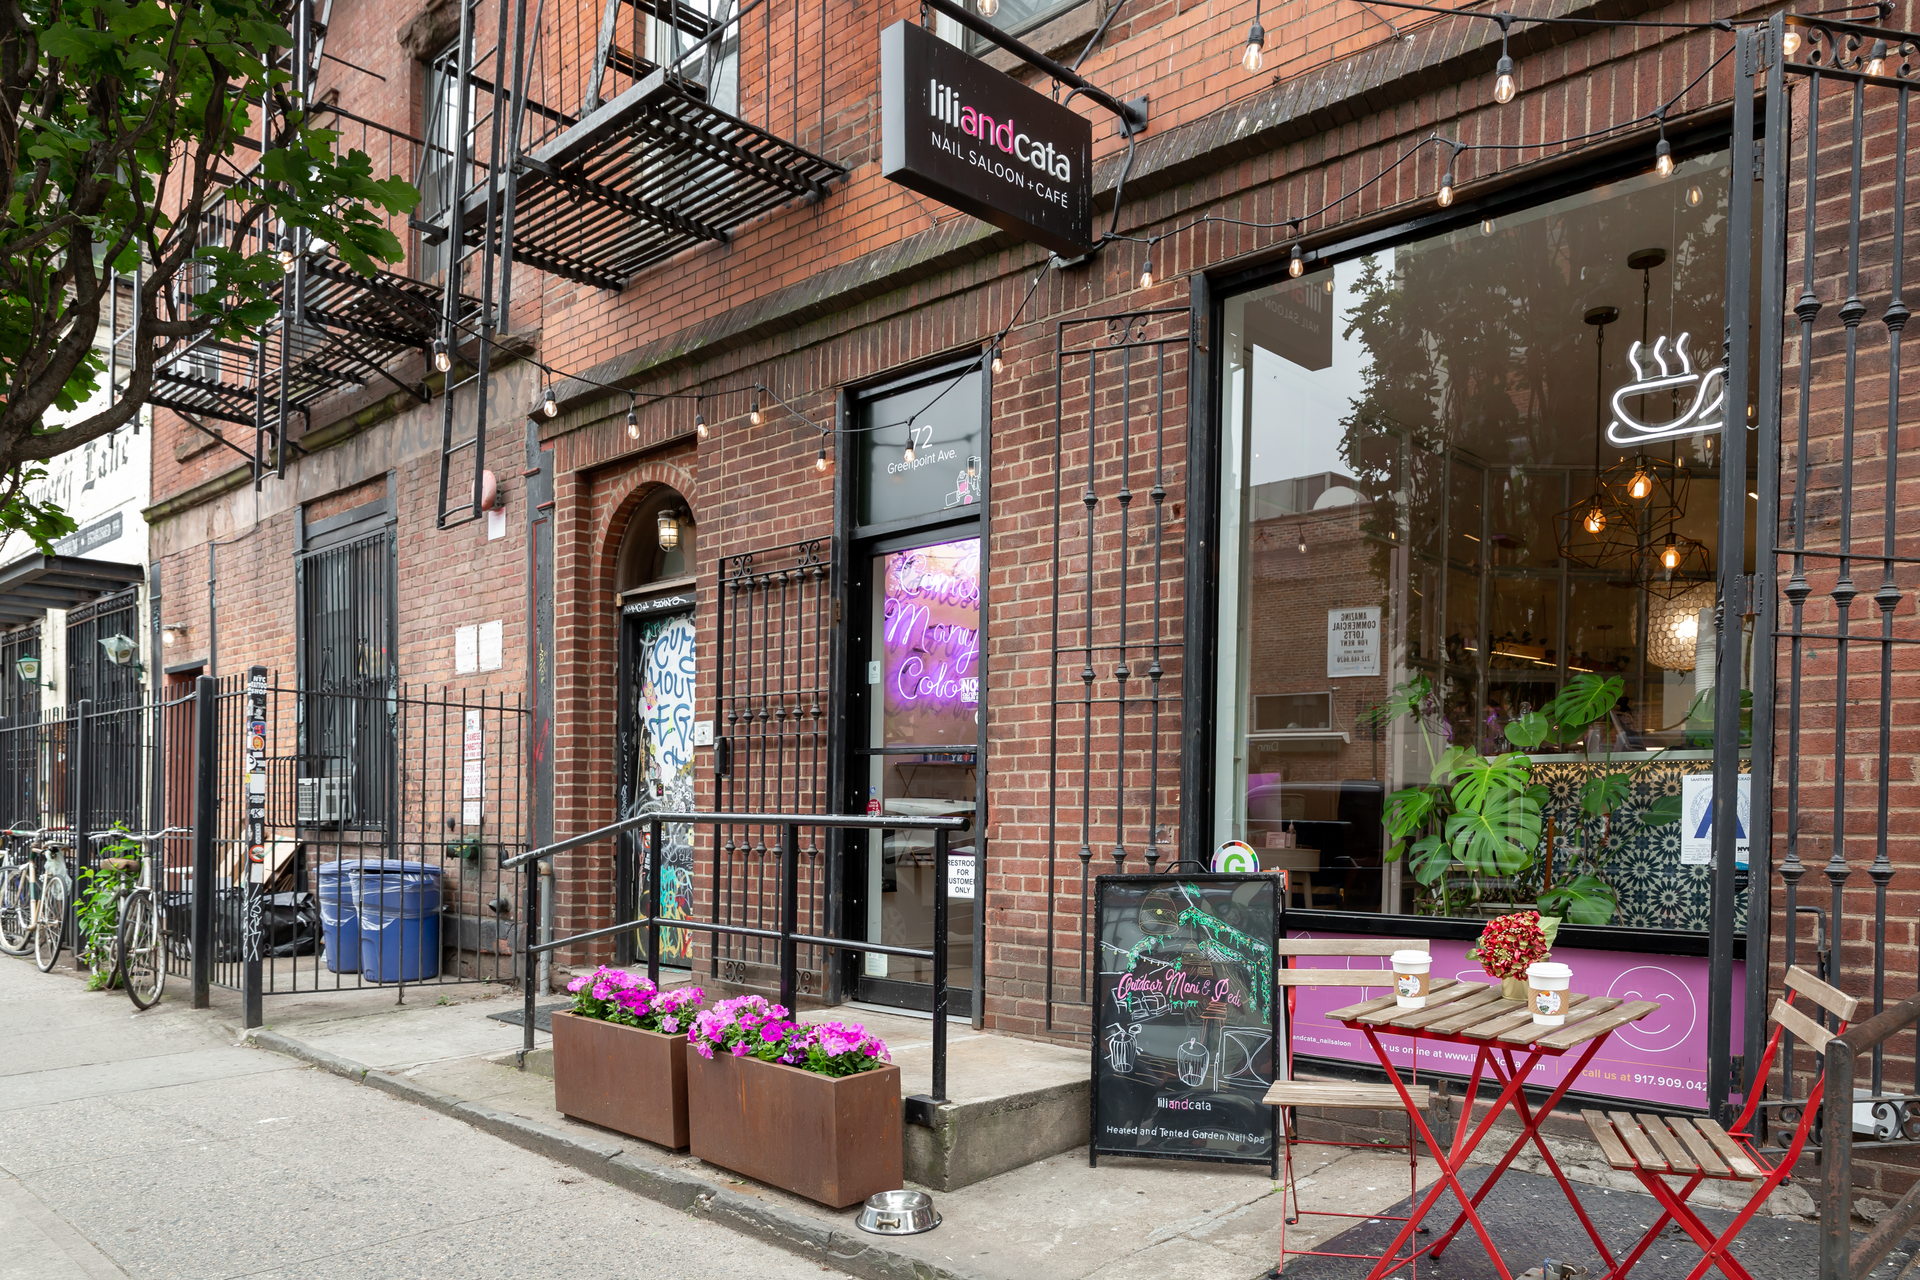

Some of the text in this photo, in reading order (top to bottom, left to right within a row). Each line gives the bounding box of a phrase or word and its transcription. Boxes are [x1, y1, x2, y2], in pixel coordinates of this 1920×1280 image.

[930, 79, 1071, 183] liliandcata
[931, 131, 964, 161] NAIL
[969, 150, 1024, 188] SALOON
[910, 425, 933, 451] 72
[887, 449, 958, 474] Greenpoint Ave.
[885, 598, 980, 674] Many
[948, 859, 976, 867] RESTROO
[1223, 853, 1246, 873] G
[954, 886, 971, 894] ONLY
[1117, 972, 1164, 1000] Outdoor
[1211, 978, 1242, 1008] Pedi
[1389, 1044, 1400, 1053] us
[1402, 1046, 1431, 1057] onine
[1432, 1049, 1443, 1058] at
[1582, 1068, 1601, 1078] call
[1604, 1071, 1617, 1080] us
[1620, 1073, 1632, 1082] at
[1157, 1096, 1212, 1111] liliandcata
[1106, 1125, 1138, 1136] Heated
[1139, 1126, 1157, 1137] and
[1160, 1127, 1189, 1139] Tented
[1192, 1130, 1225, 1141] Garden
[1247, 1133, 1265, 1145] Spa
